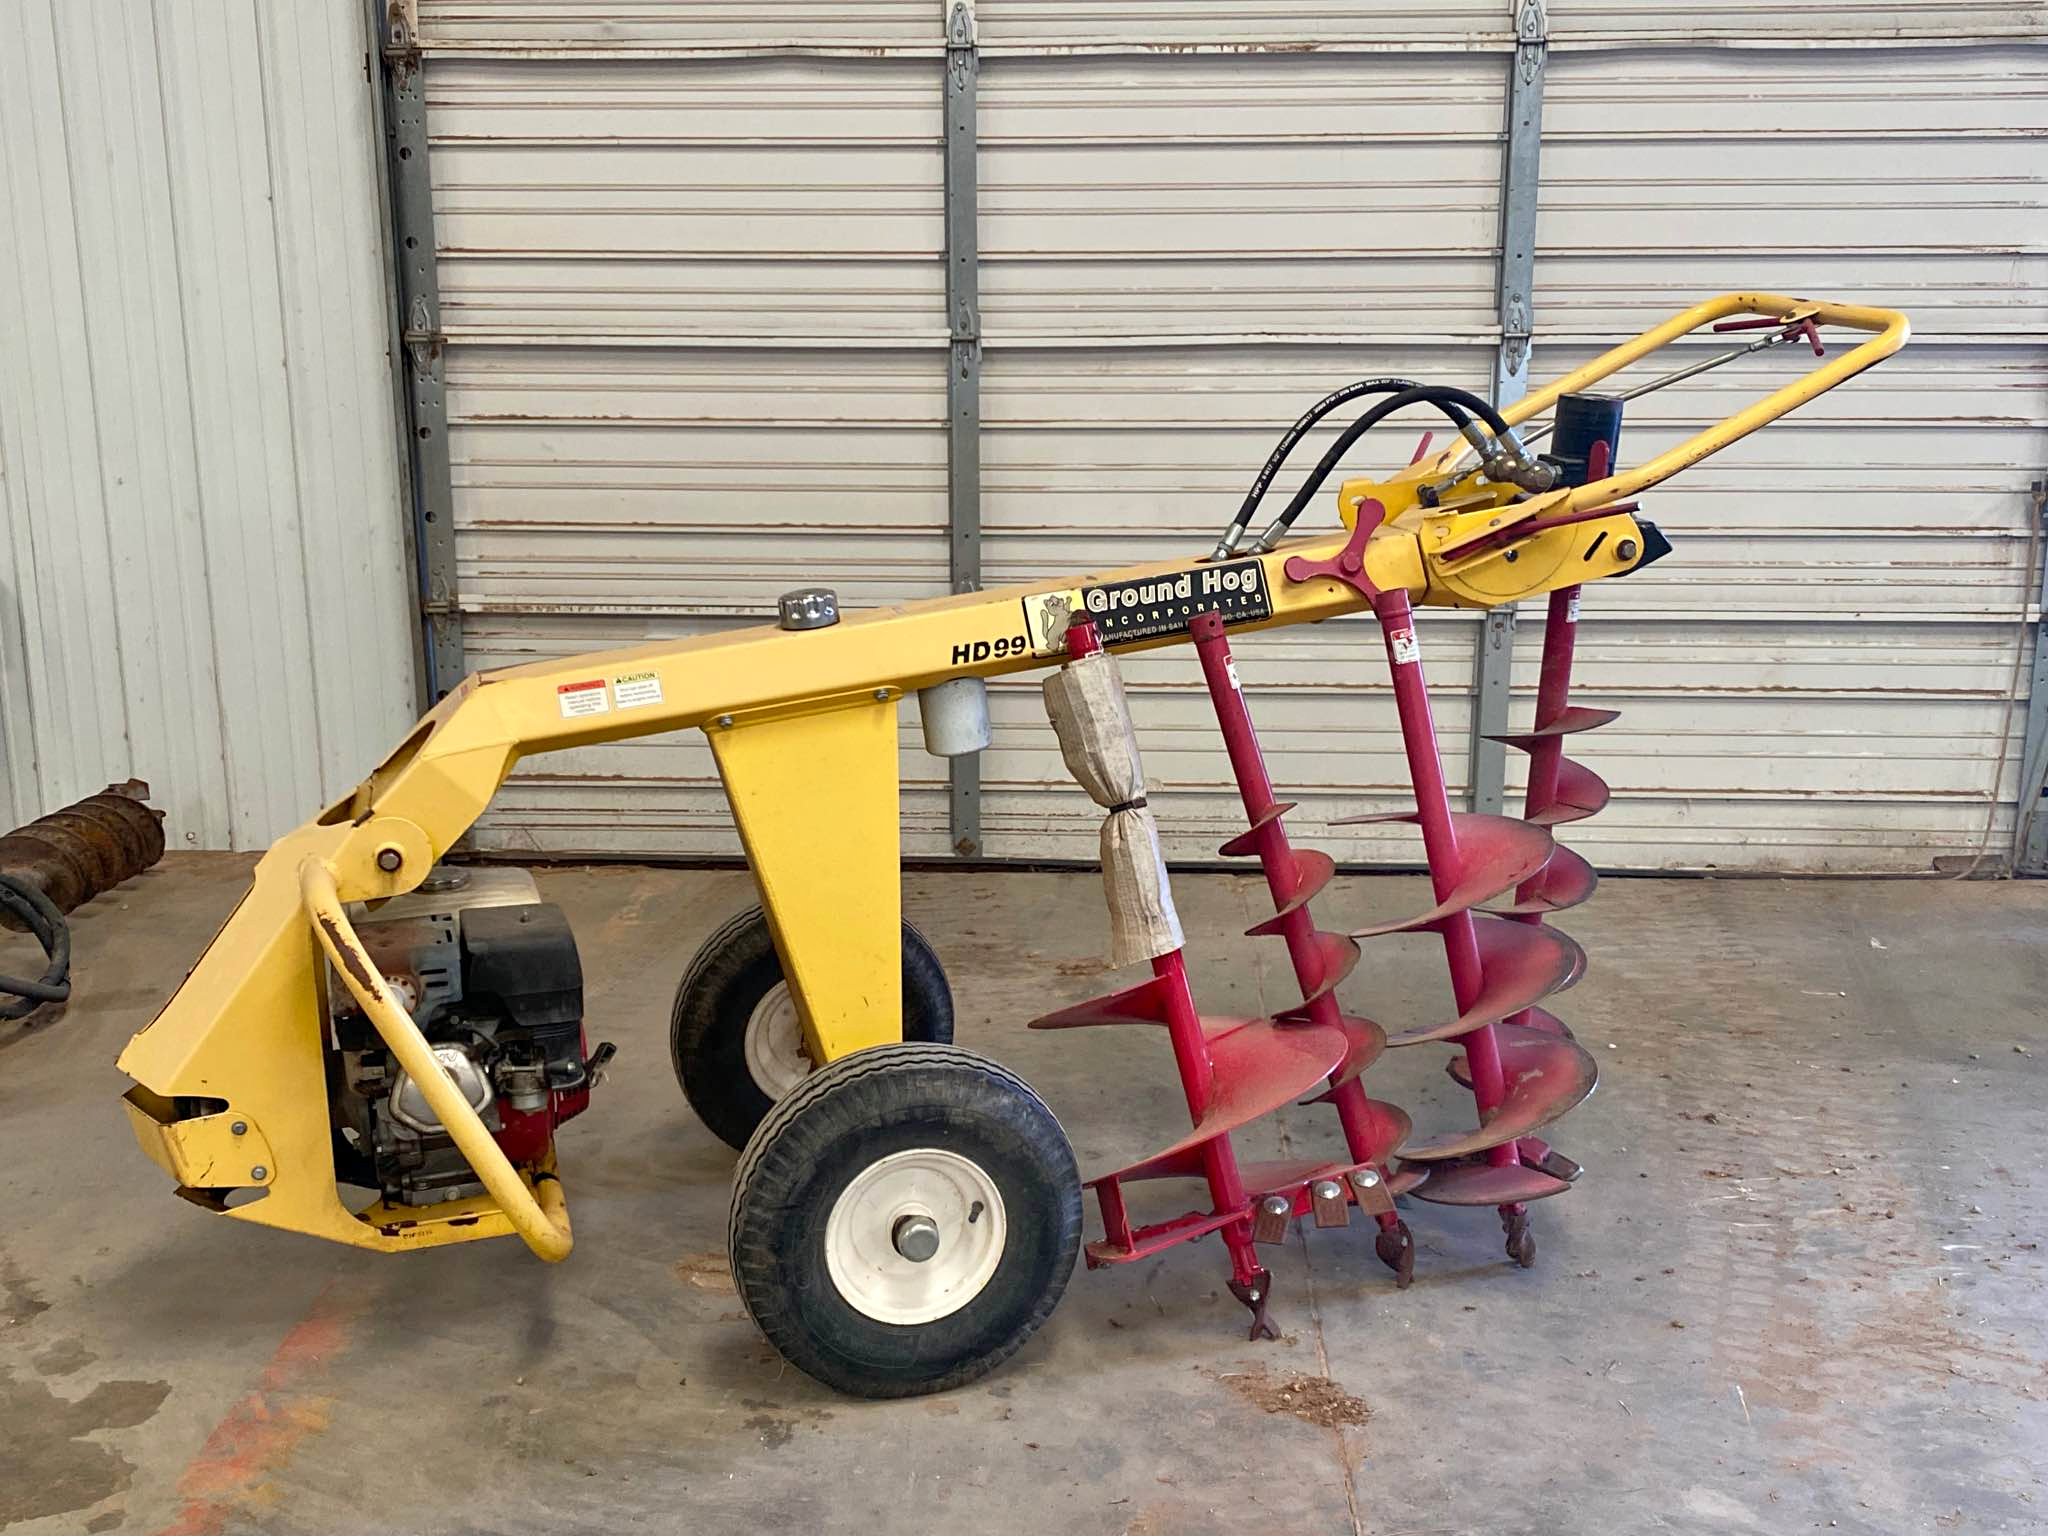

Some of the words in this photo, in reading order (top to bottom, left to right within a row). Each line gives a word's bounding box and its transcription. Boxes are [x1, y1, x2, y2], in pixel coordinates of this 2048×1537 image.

[1086, 573, 1192, 613] Ground
[1202, 568, 1257, 594] Hog
[1105, 594, 1262, 628] NCORPORATED
[1102, 625, 1157, 642] ANUFACTURED
[951, 635, 1026, 666] HD99
[622, 672, 656, 683] CAUTION
